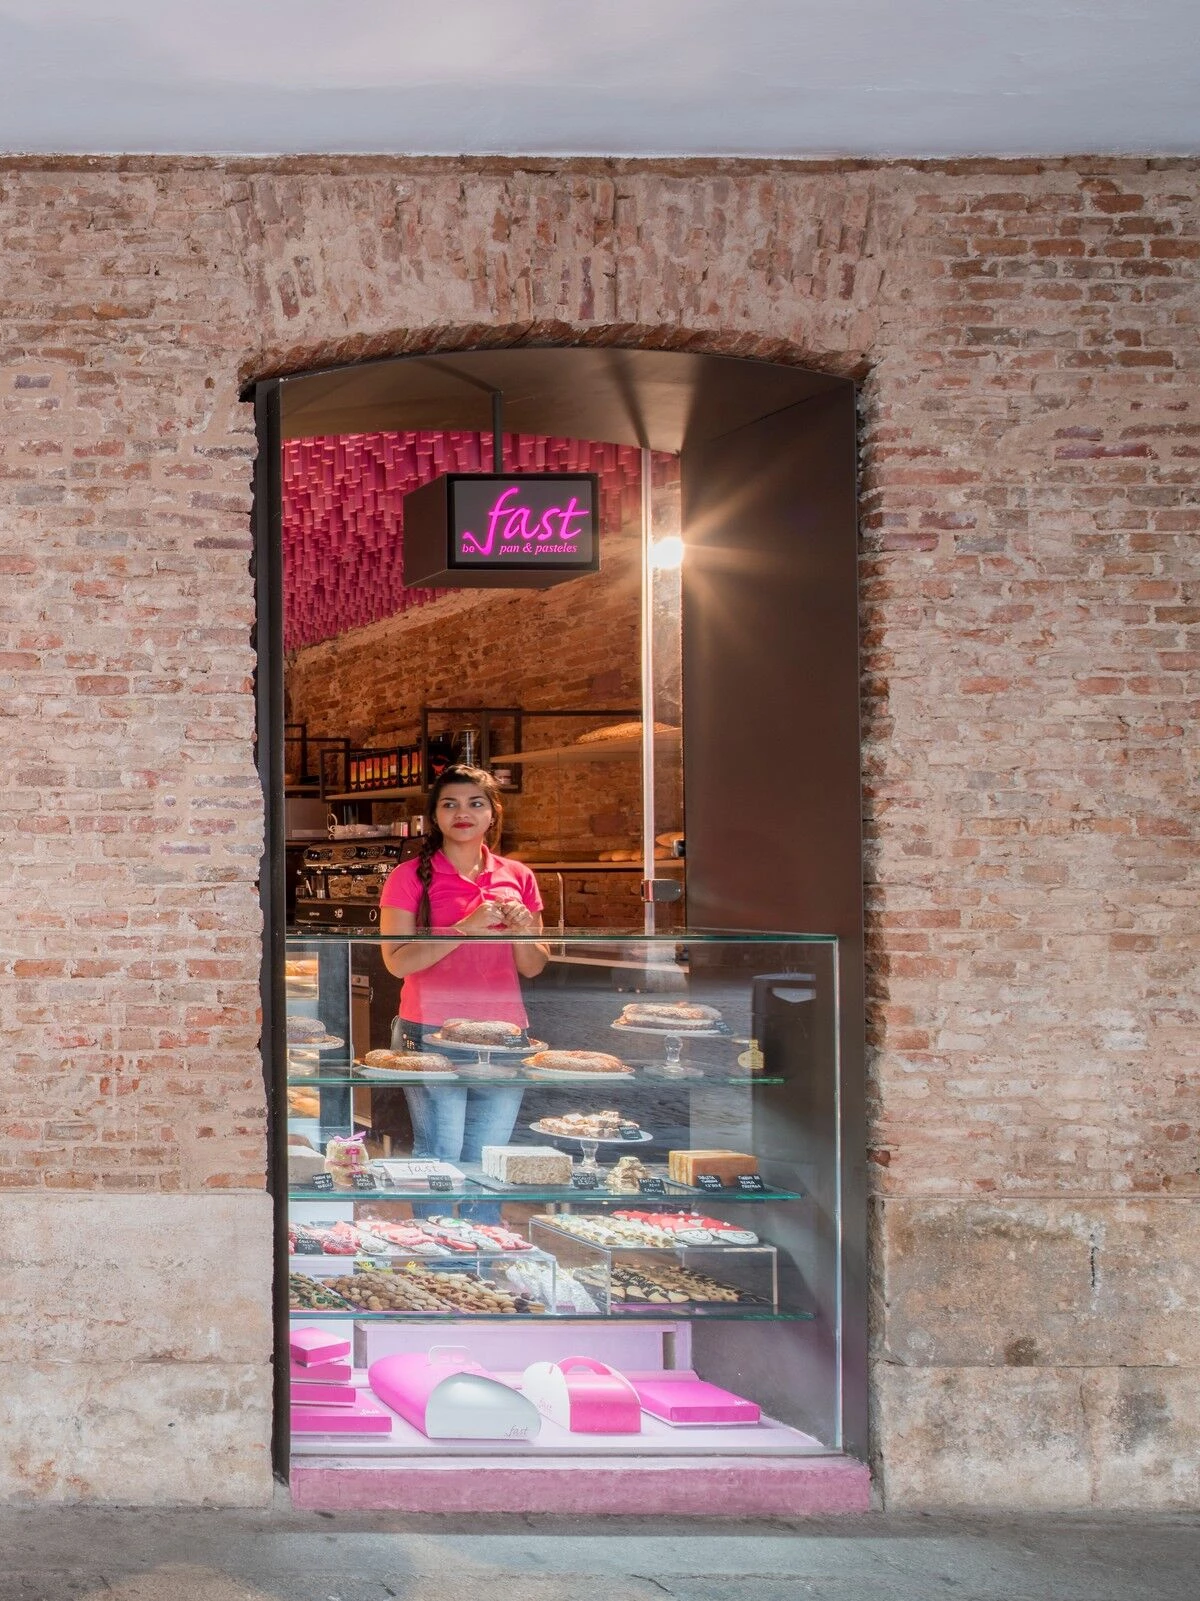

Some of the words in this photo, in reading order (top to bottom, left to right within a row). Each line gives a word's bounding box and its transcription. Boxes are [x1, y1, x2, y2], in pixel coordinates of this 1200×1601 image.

[462, 487, 590, 555] fast
[499, 545, 520, 555] pan
[522, 542, 533, 553] &
[534, 543, 578, 555] pasteles
